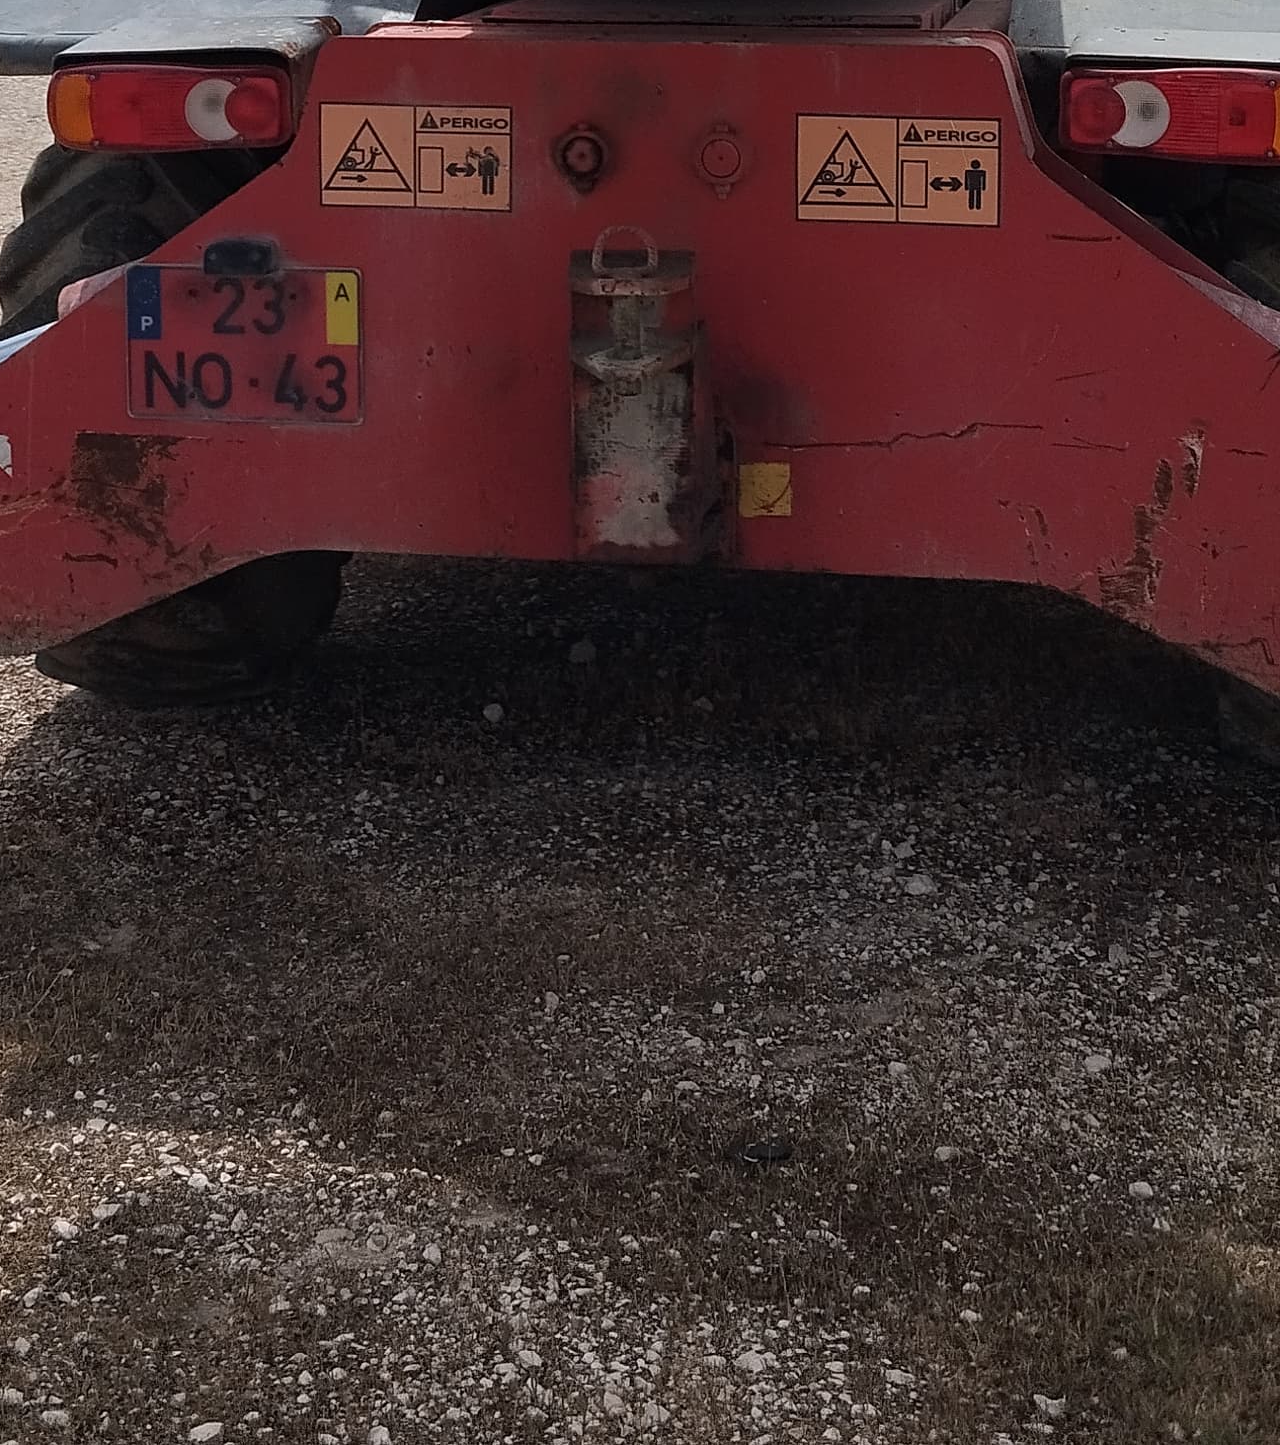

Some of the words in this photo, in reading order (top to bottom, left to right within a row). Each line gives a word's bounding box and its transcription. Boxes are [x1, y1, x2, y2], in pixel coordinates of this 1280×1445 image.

[440, 116, 509, 130] PERIGO
[924, 129, 997, 143] PERIGO
[334, 283, 350, 302] A
[212, 277, 286, 335] 23
[140, 315, 153, 331] P
